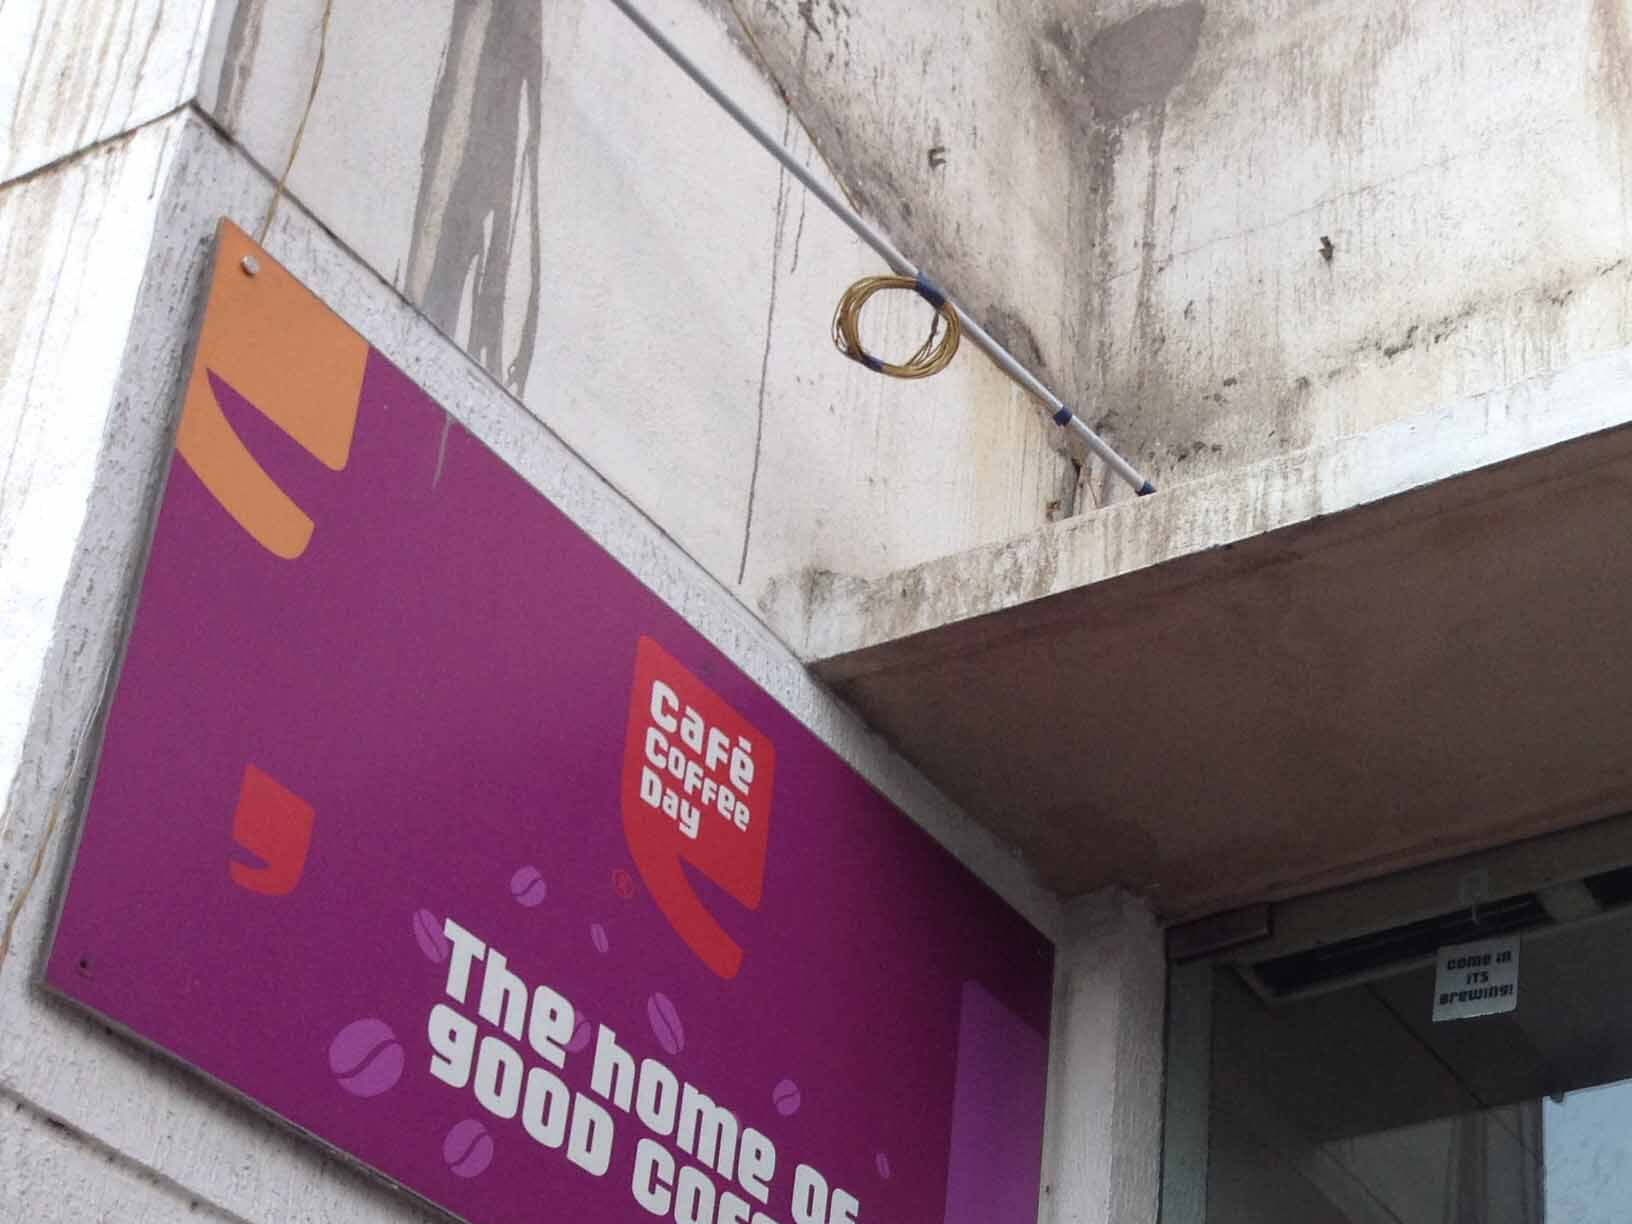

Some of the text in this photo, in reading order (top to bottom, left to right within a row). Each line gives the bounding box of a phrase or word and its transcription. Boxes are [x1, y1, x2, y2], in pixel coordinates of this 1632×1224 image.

[640, 765, 700, 839] Day
[443, 918, 575, 1068] The
[591, 1023, 777, 1201] home
